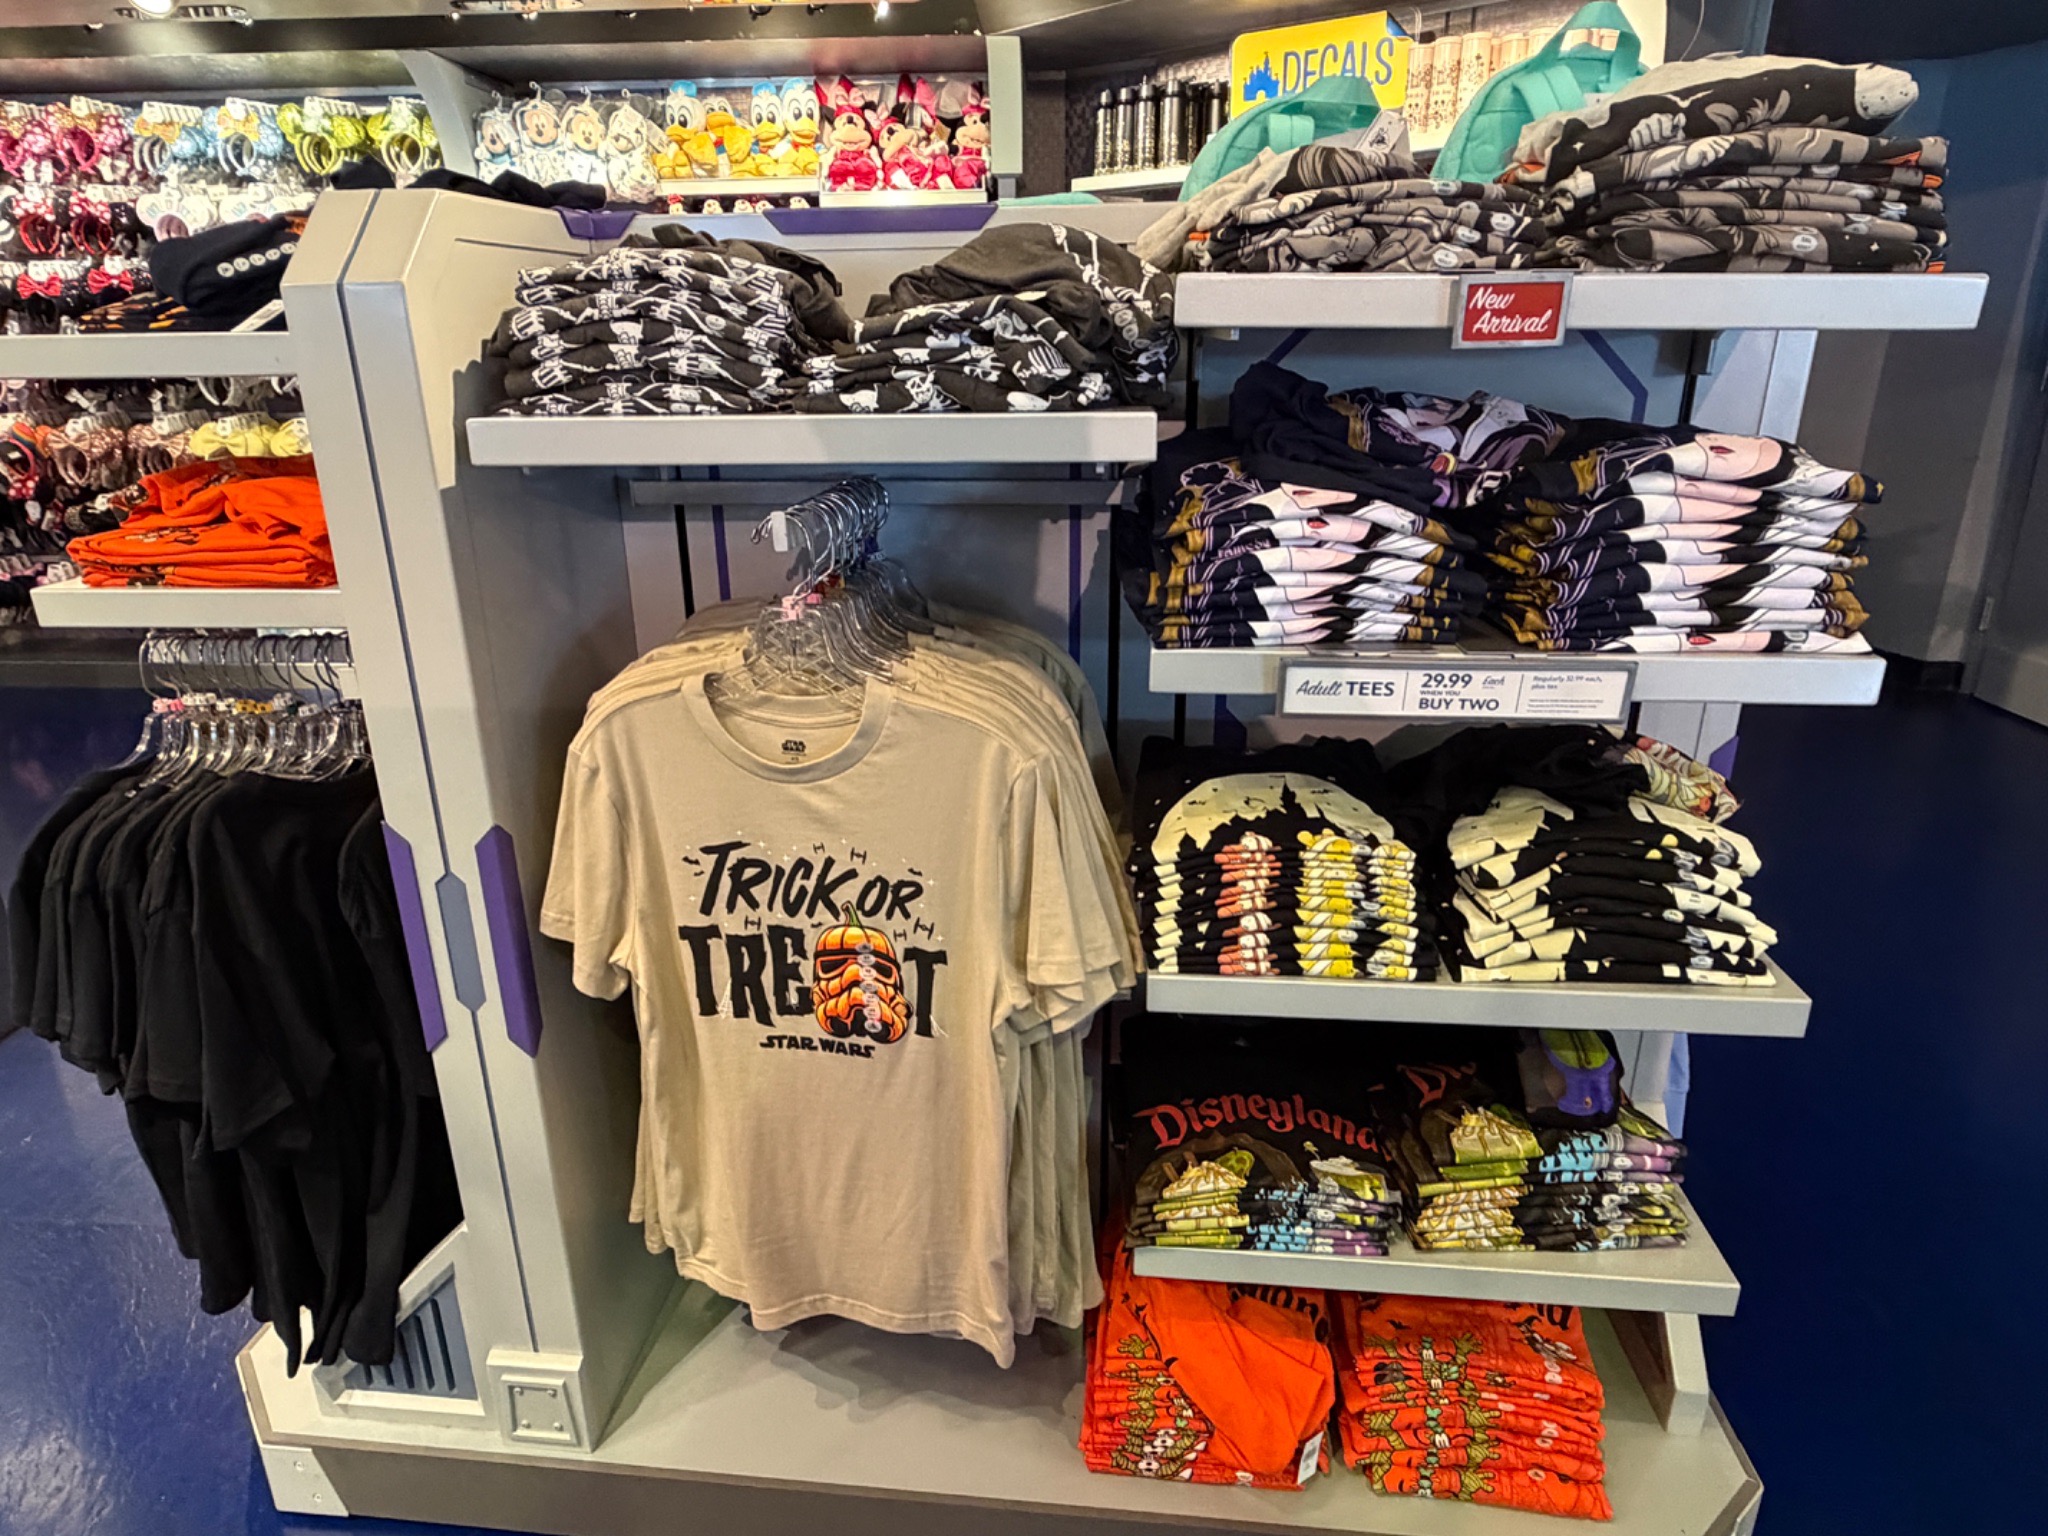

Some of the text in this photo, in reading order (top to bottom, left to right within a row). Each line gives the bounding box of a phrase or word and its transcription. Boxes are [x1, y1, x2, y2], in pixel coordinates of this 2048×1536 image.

[1282, 37, 1394, 93] DECALS
[1469, 286, 1515, 310] New
[1472, 309, 1553, 334] Arrival
[1297, 680, 1395, 697] Adult TEES
[1421, 673, 1473, 689] 29.99
[1418, 697, 1500, 711] BUY TWO
[856, 875, 923, 920] OR
[760, 1035, 876, 1059] STAR WARS
